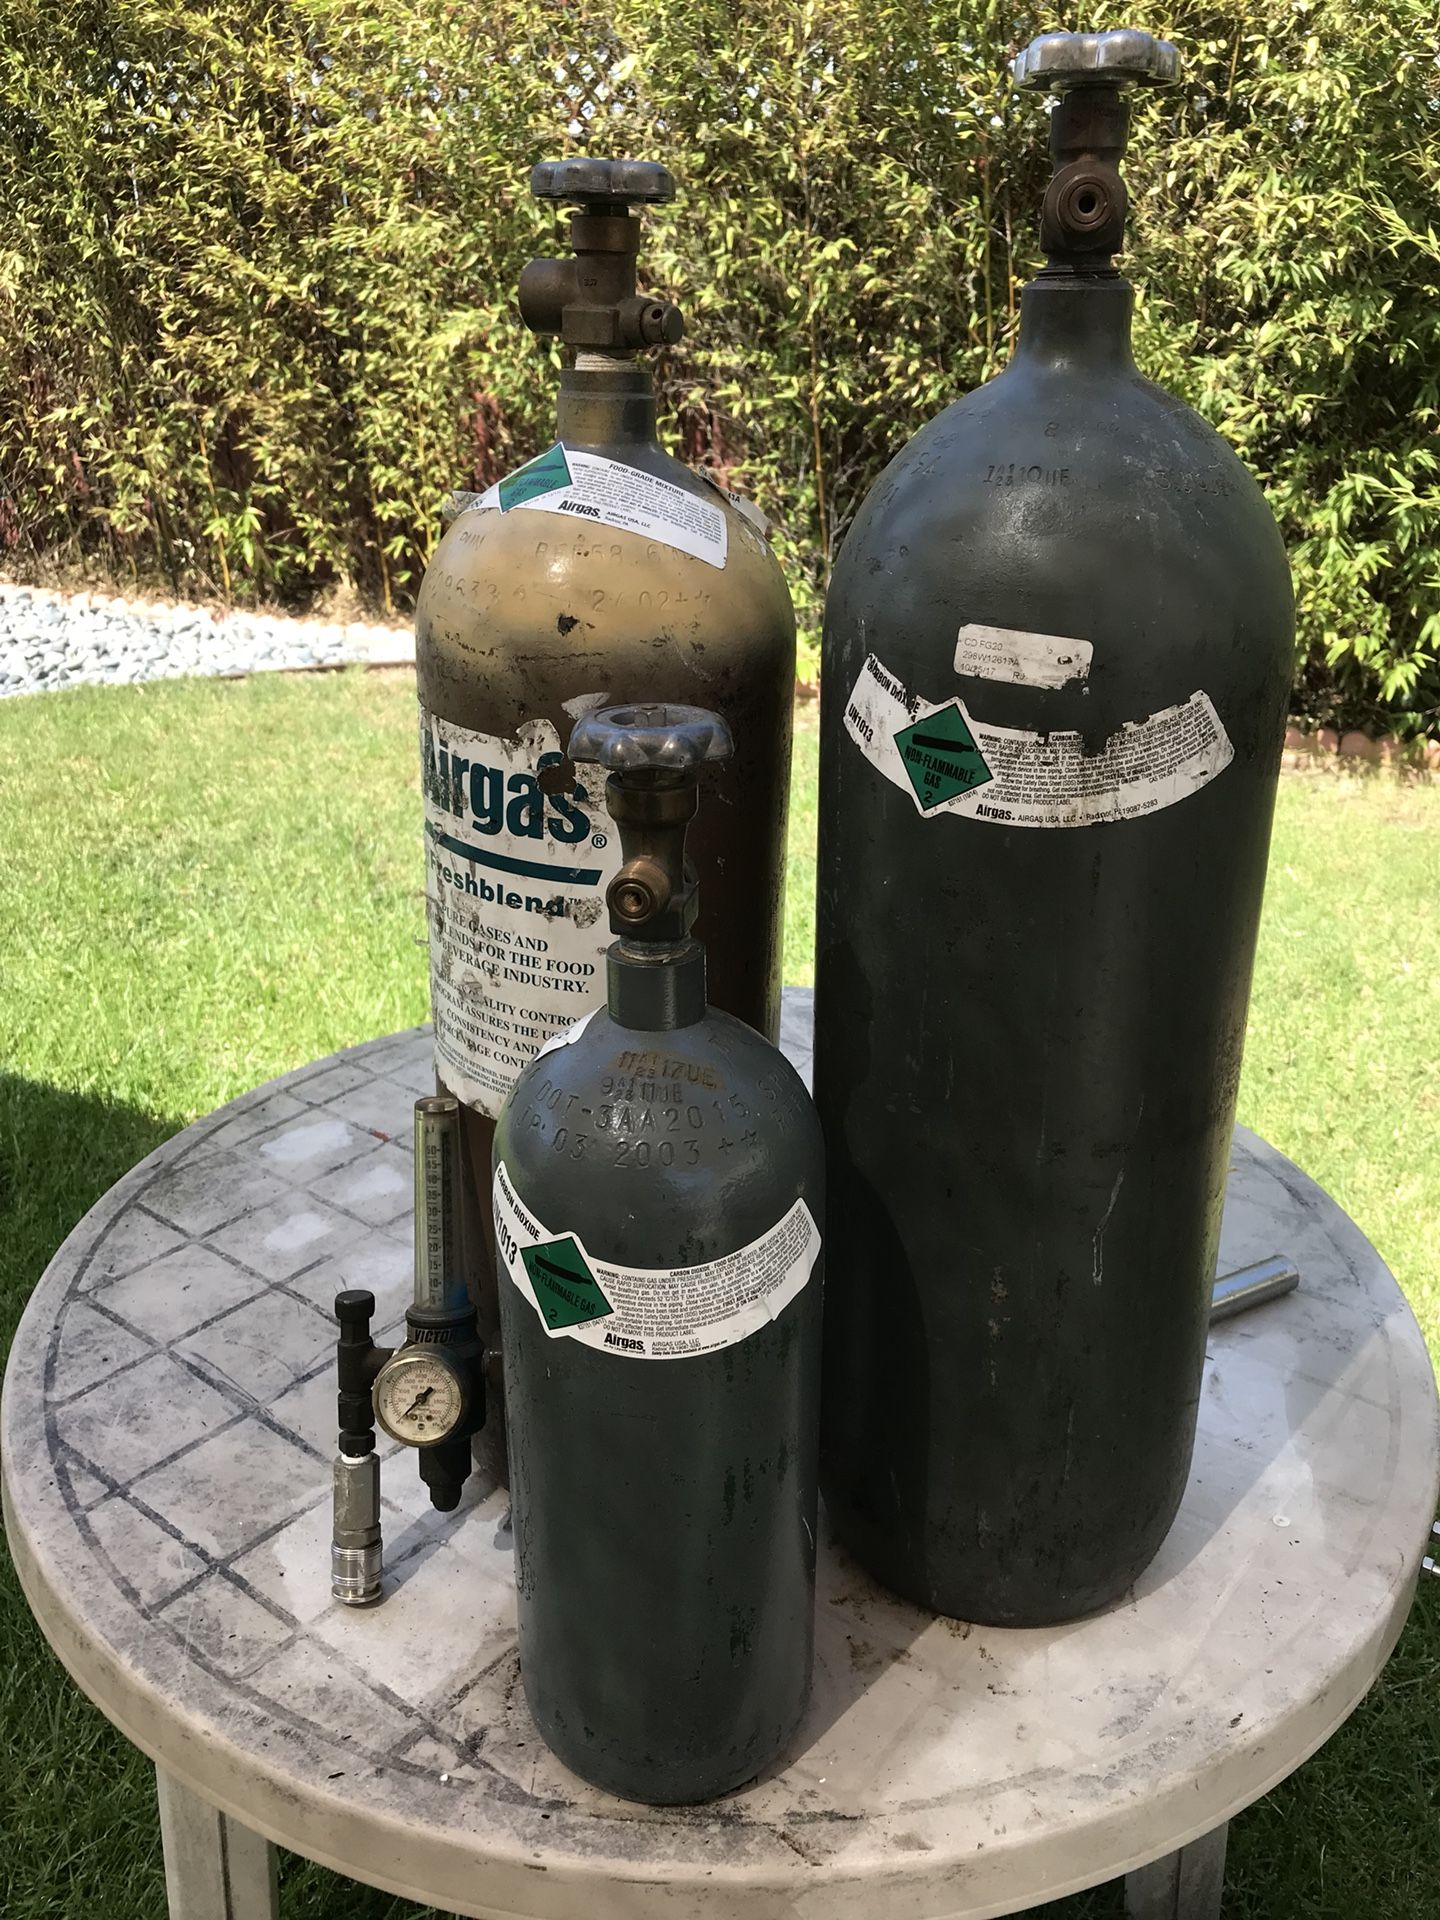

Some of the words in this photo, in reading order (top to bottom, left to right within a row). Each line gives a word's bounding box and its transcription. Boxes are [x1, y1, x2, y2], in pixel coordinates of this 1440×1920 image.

[609, 463, 653, 483] FOOD-GRADE
[655, 480, 685, 497] MIXTURE
[963, 637, 977, 647] CD
[979, 640, 1003, 651] FG20
[848, 704, 874, 742] UN1013
[904, 745, 976, 785] NON-FLAMMABLE
[923, 771, 942, 789] GAS
[924, 790, 933, 803] 2
[1018, 815, 1043, 823] AIRGAS
[1122, 798, 1158, 815] 19087-5283
[514, 934, 549, 952] AND
[442, 937, 500, 977] BEVERAGE
[503, 967, 590, 994] INDUSTRY.
[478, 941, 507, 961] FOR
[509, 950, 542, 970] THE
[546, 959, 596, 976] FOOD
[465, 1007, 511, 1031] ASSURES
[512, 1024, 539, 1039] THE
[519, 1006, 579, 1027] CONTRO
[446, 1008, 511, 1048] CONSISTENCY
[513, 1042, 540, 1055] AND
[614, 1139, 700, 1168] 2003
[497, 1167, 514, 1208] CARBON
[513, 1204, 541, 1241] DIOXIDE
[549, 1308, 558, 1323] 2
[580, 1297, 597, 1316] GAS
[415, 1329, 456, 1343] VICTOR
[622, 1326, 642, 1337] REMOVE
[643, 1329, 655, 1337] THIS
[656, 1329, 679, 1338] PRODUCT
